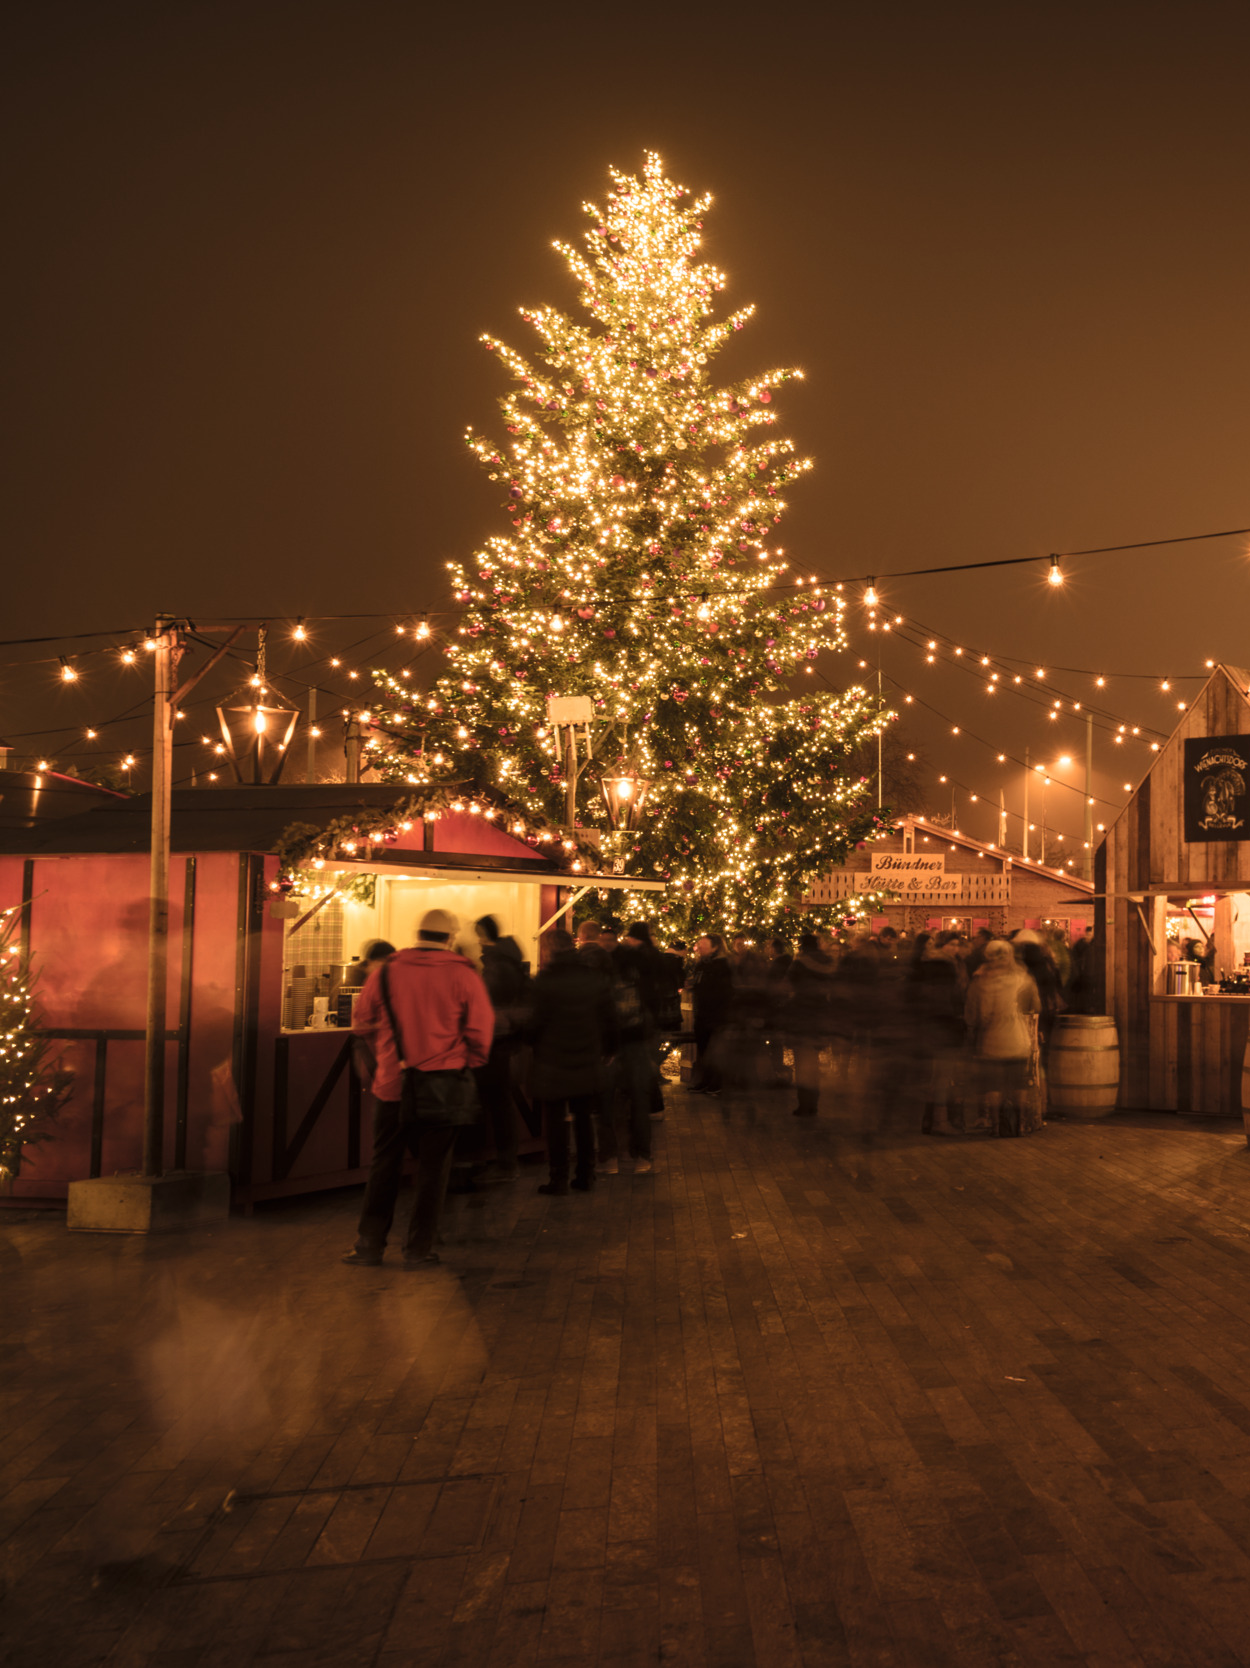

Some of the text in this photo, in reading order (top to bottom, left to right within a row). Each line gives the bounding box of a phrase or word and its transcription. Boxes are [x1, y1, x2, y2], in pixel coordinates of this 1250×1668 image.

[614, 858, 625, 872] 39
[875, 855, 943, 871] Bündner
[860, 876, 959, 891] Hütte & Bar
